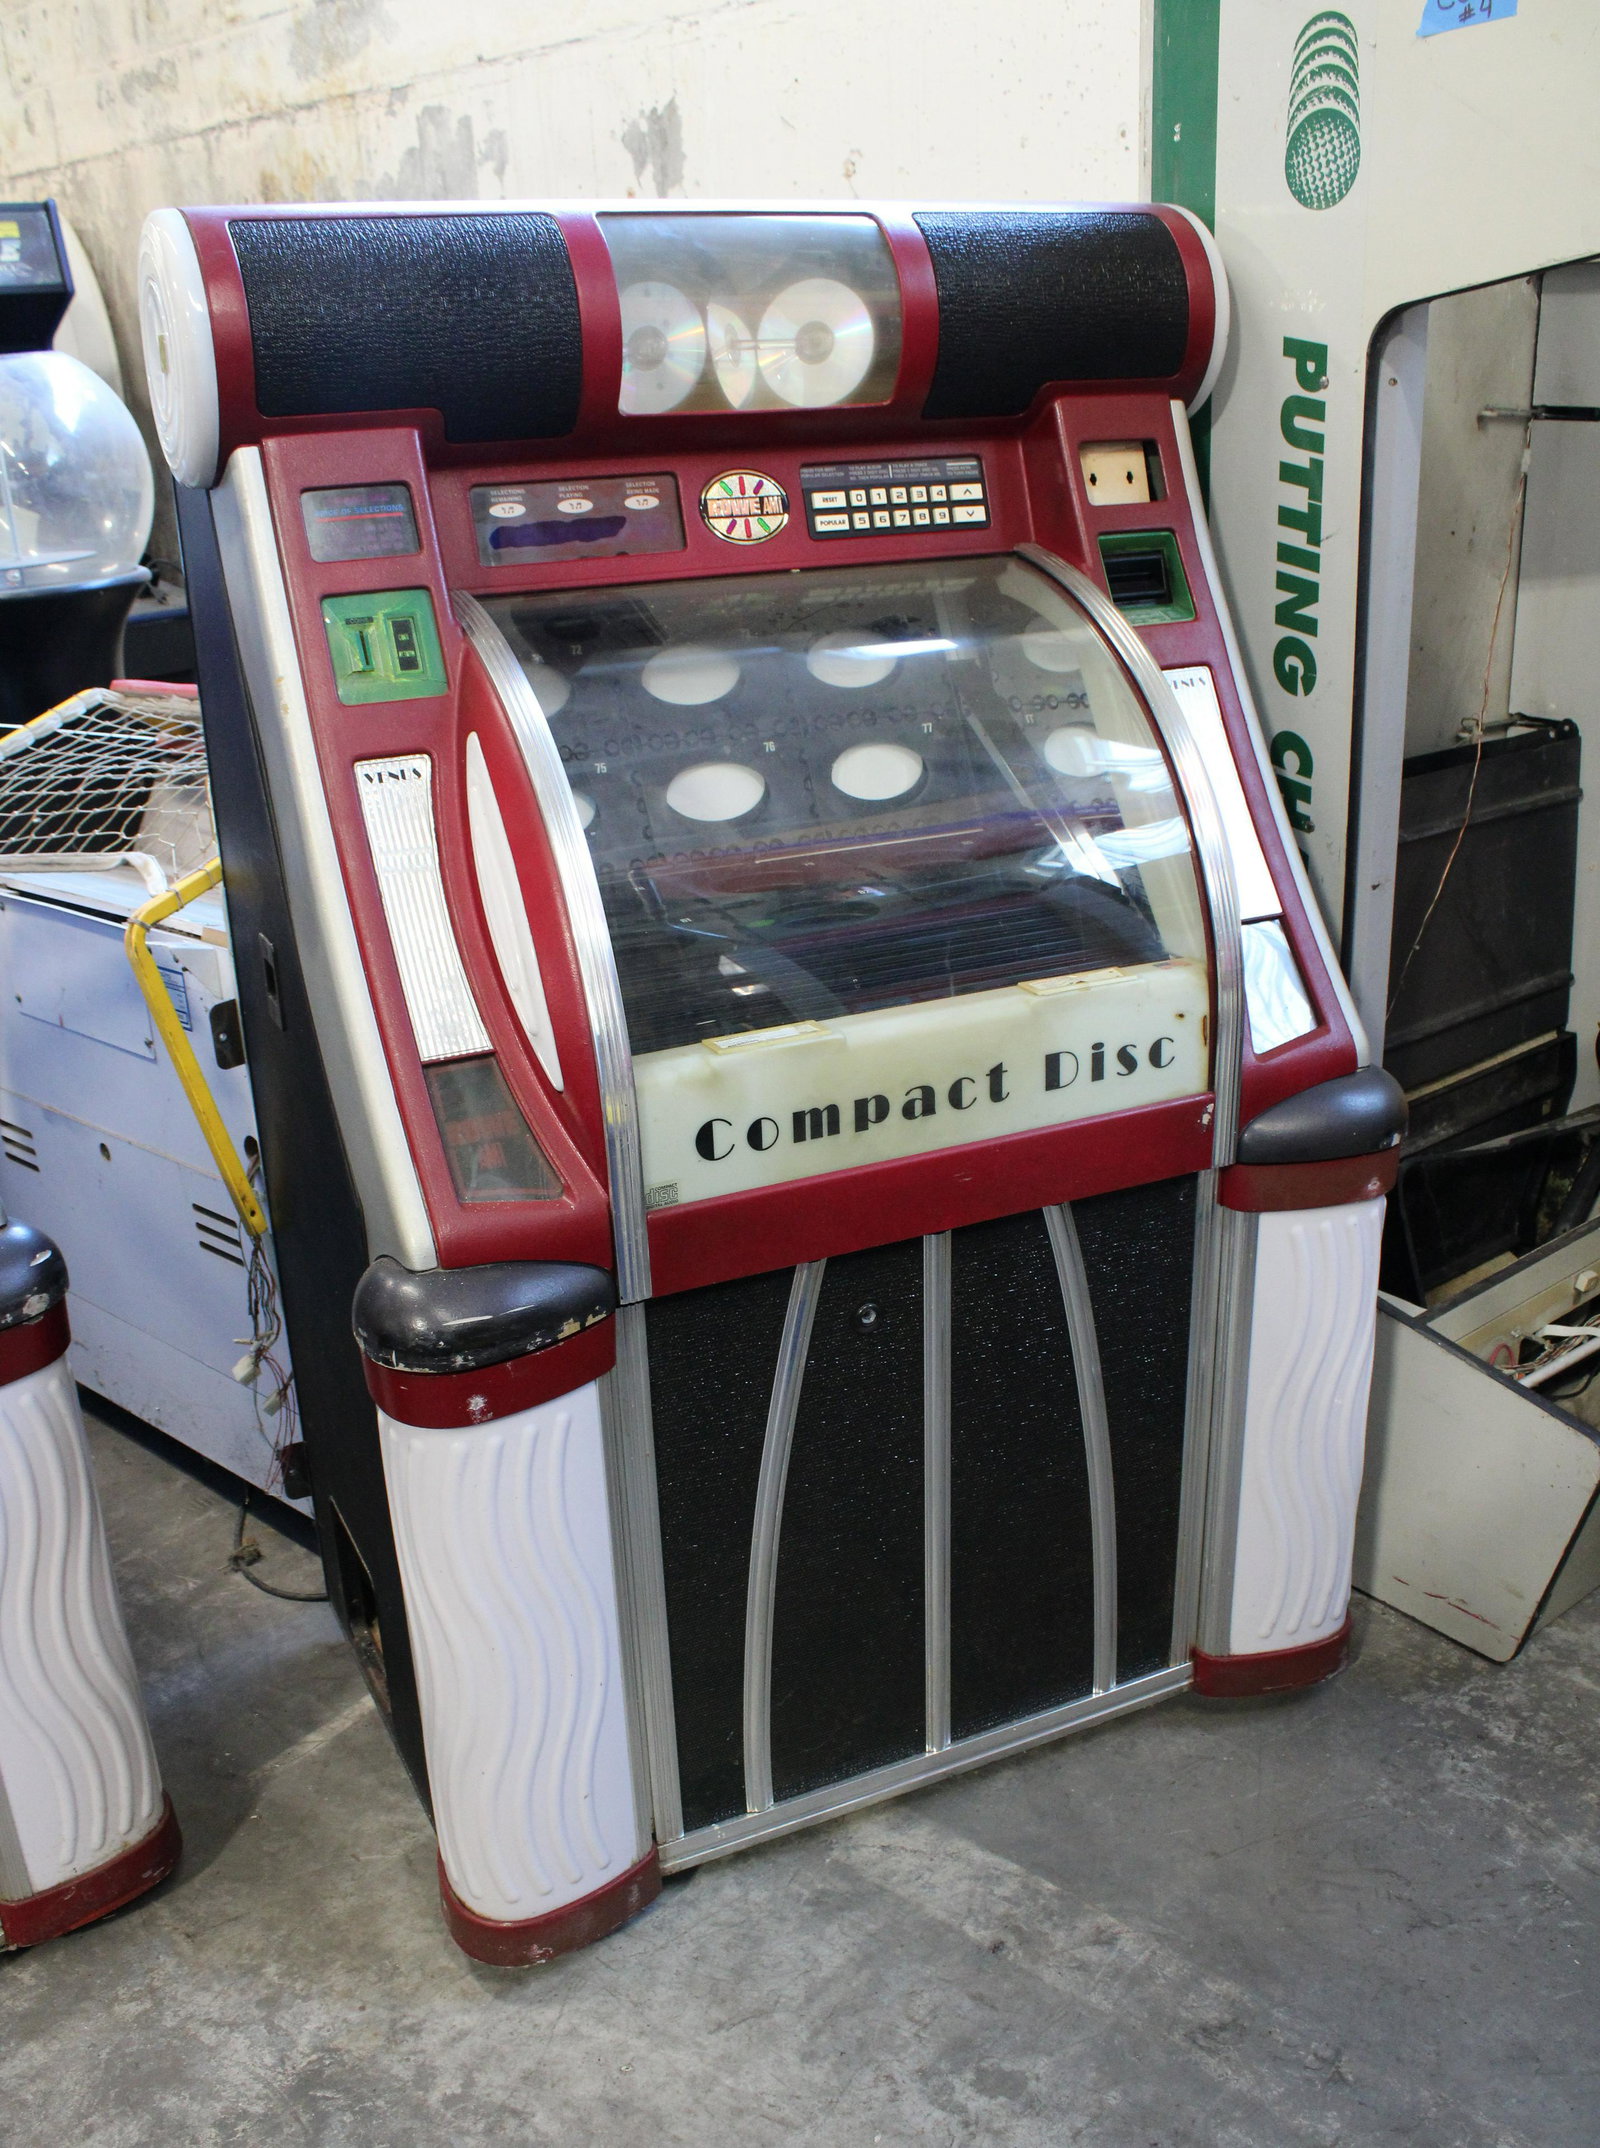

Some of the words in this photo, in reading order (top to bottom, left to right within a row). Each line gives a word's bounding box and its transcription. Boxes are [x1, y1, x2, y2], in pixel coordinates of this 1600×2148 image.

[856, 493, 863, 502] 0
[876, 492, 881, 500] 1
[896, 491, 904, 499] 2
[916, 490, 924, 498] 3
[936, 489, 943, 497] 4
[858, 516, 866, 524] 5
[879, 515, 887, 523] 6
[919, 512, 926, 520] 8
[939, 511, 946, 519] 9
[1273, 336, 1328, 696] PUTTING
[763, 741, 776, 753] 76
[594, 762, 607, 774] 75
[695, 1062, 1010, 1161] Compact
[1045, 1037, 1175, 1092] Disc
